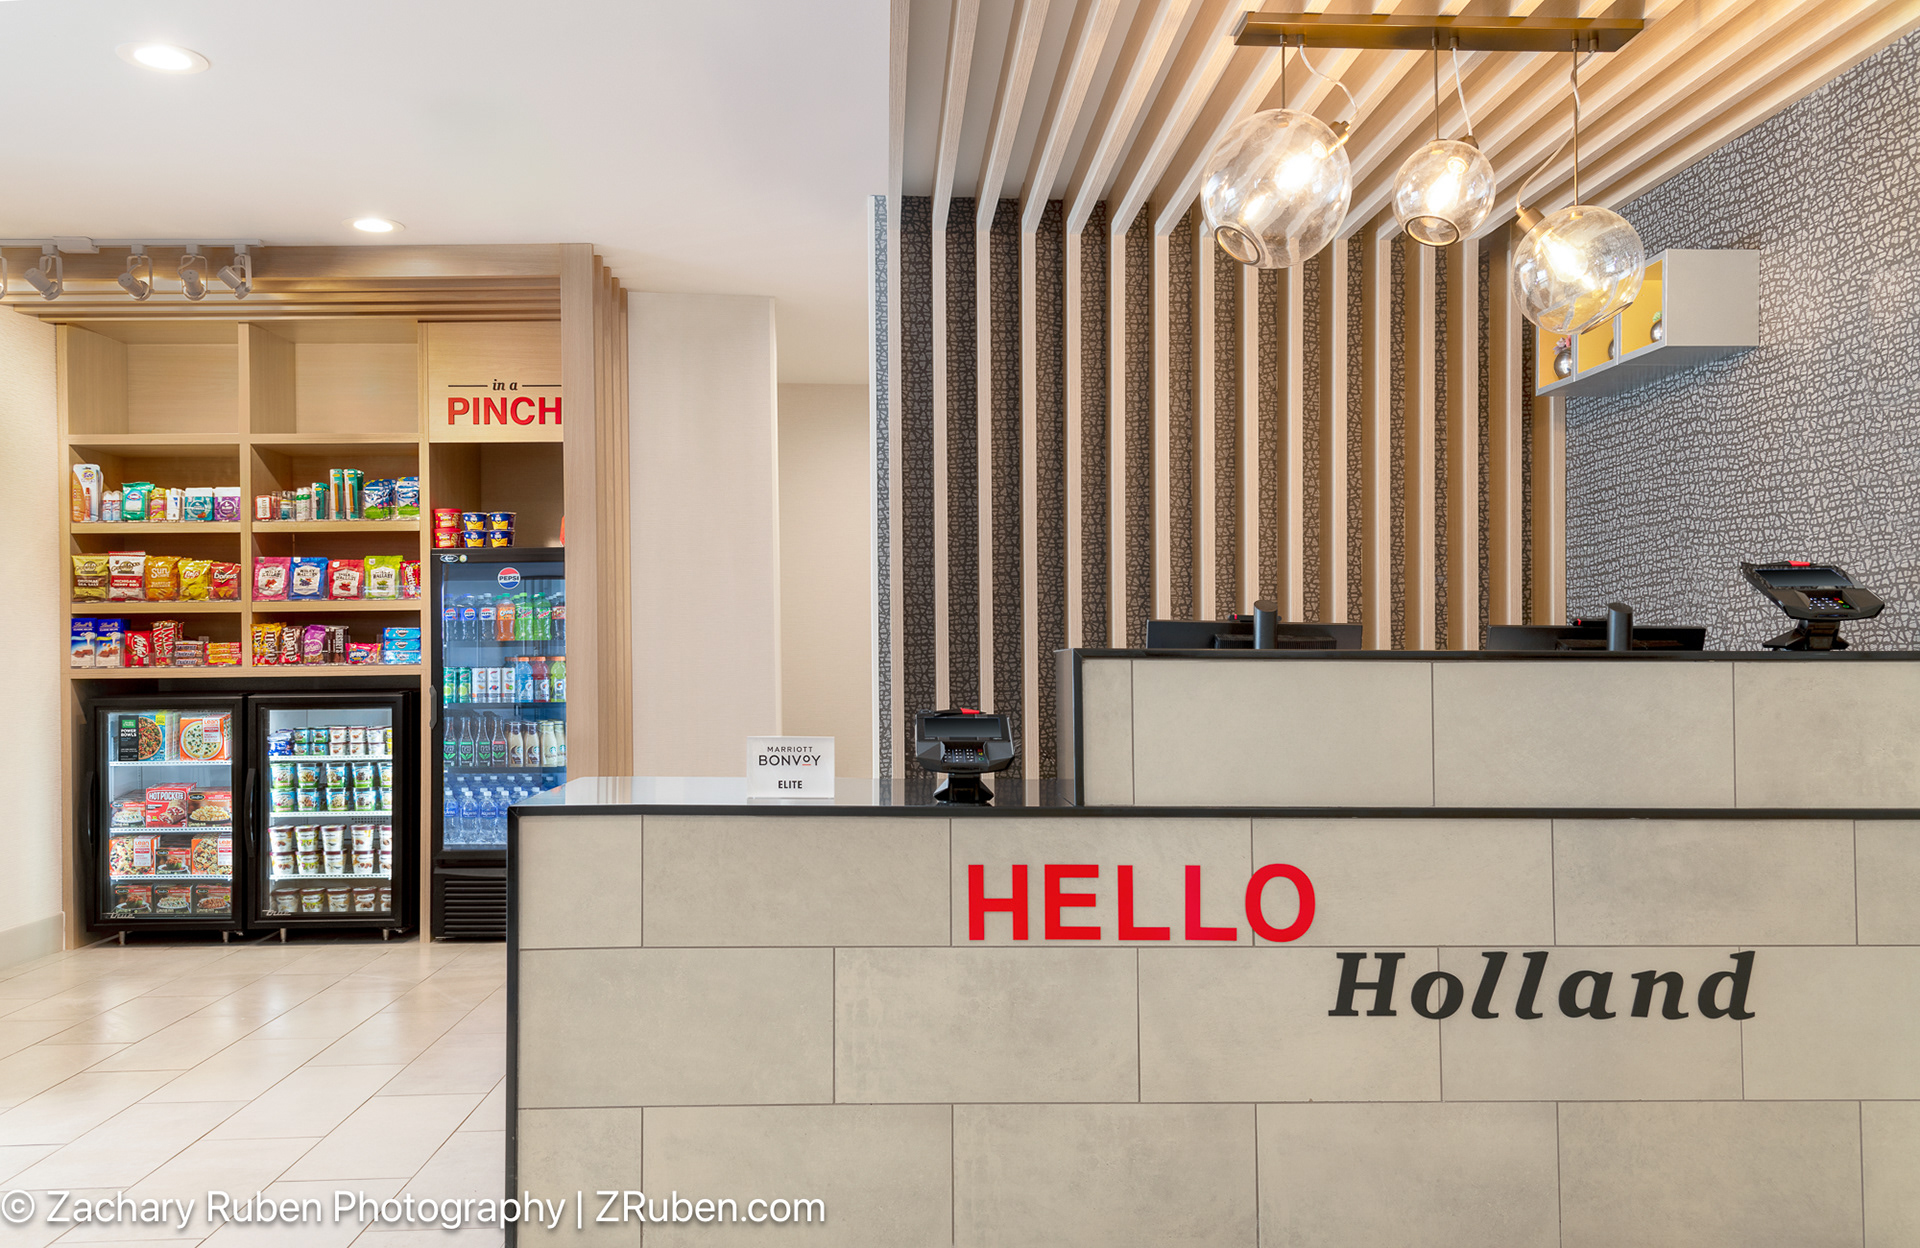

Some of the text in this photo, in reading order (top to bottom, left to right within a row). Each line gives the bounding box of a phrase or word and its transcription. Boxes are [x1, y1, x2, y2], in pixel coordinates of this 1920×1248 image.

[492, 379, 518, 391] in a
[447, 396, 562, 425] PINCH
[758, 755, 821, 766] BONVOY
[778, 780, 803, 789] ELITE
[148, 791, 160, 800] HOT
[967, 863, 1316, 943] HELLO
[1328, 950, 1756, 1020] Holland
